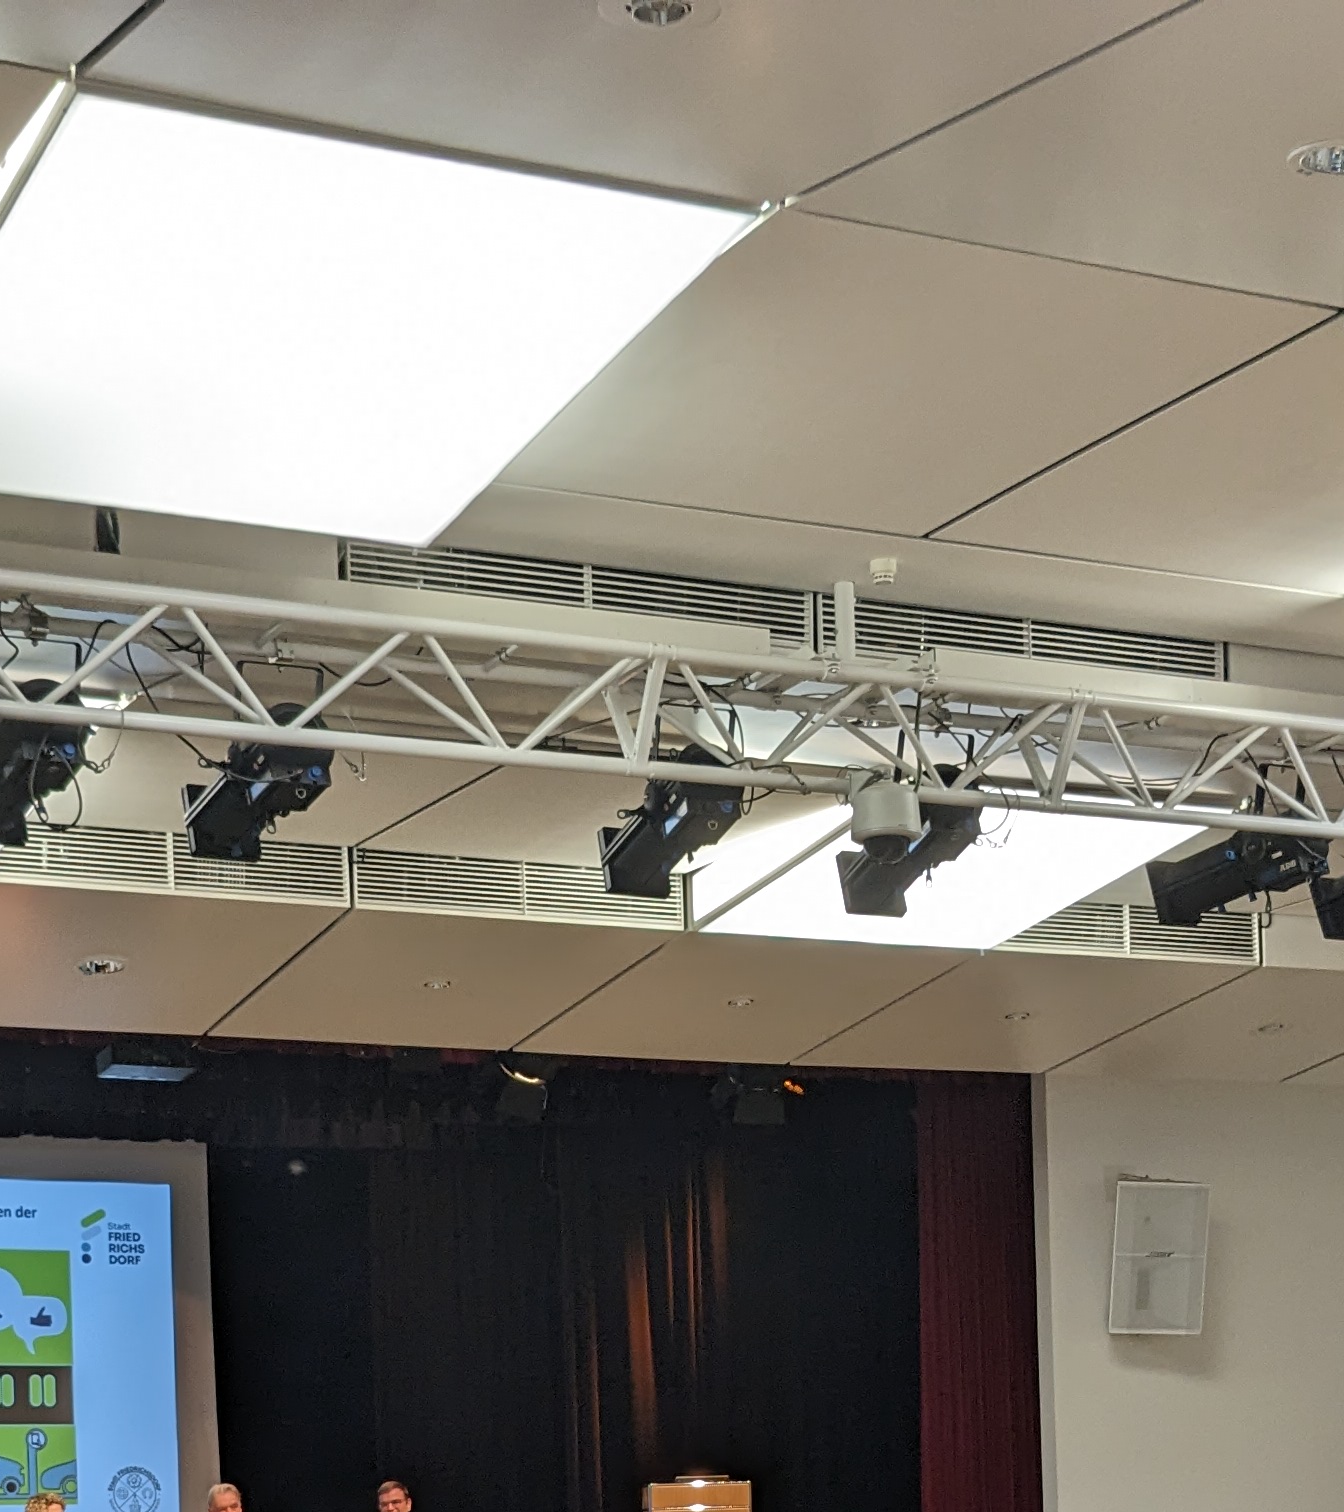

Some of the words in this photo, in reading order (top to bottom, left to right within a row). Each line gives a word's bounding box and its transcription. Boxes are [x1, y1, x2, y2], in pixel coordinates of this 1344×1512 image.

[15, 1206, 38, 1219] der
[107, 1221, 132, 1231] Stadt
[108, 1231, 142, 1242] FRIED
[108, 1243, 146, 1254] RICHS
[109, 1254, 142, 1265] DORF
